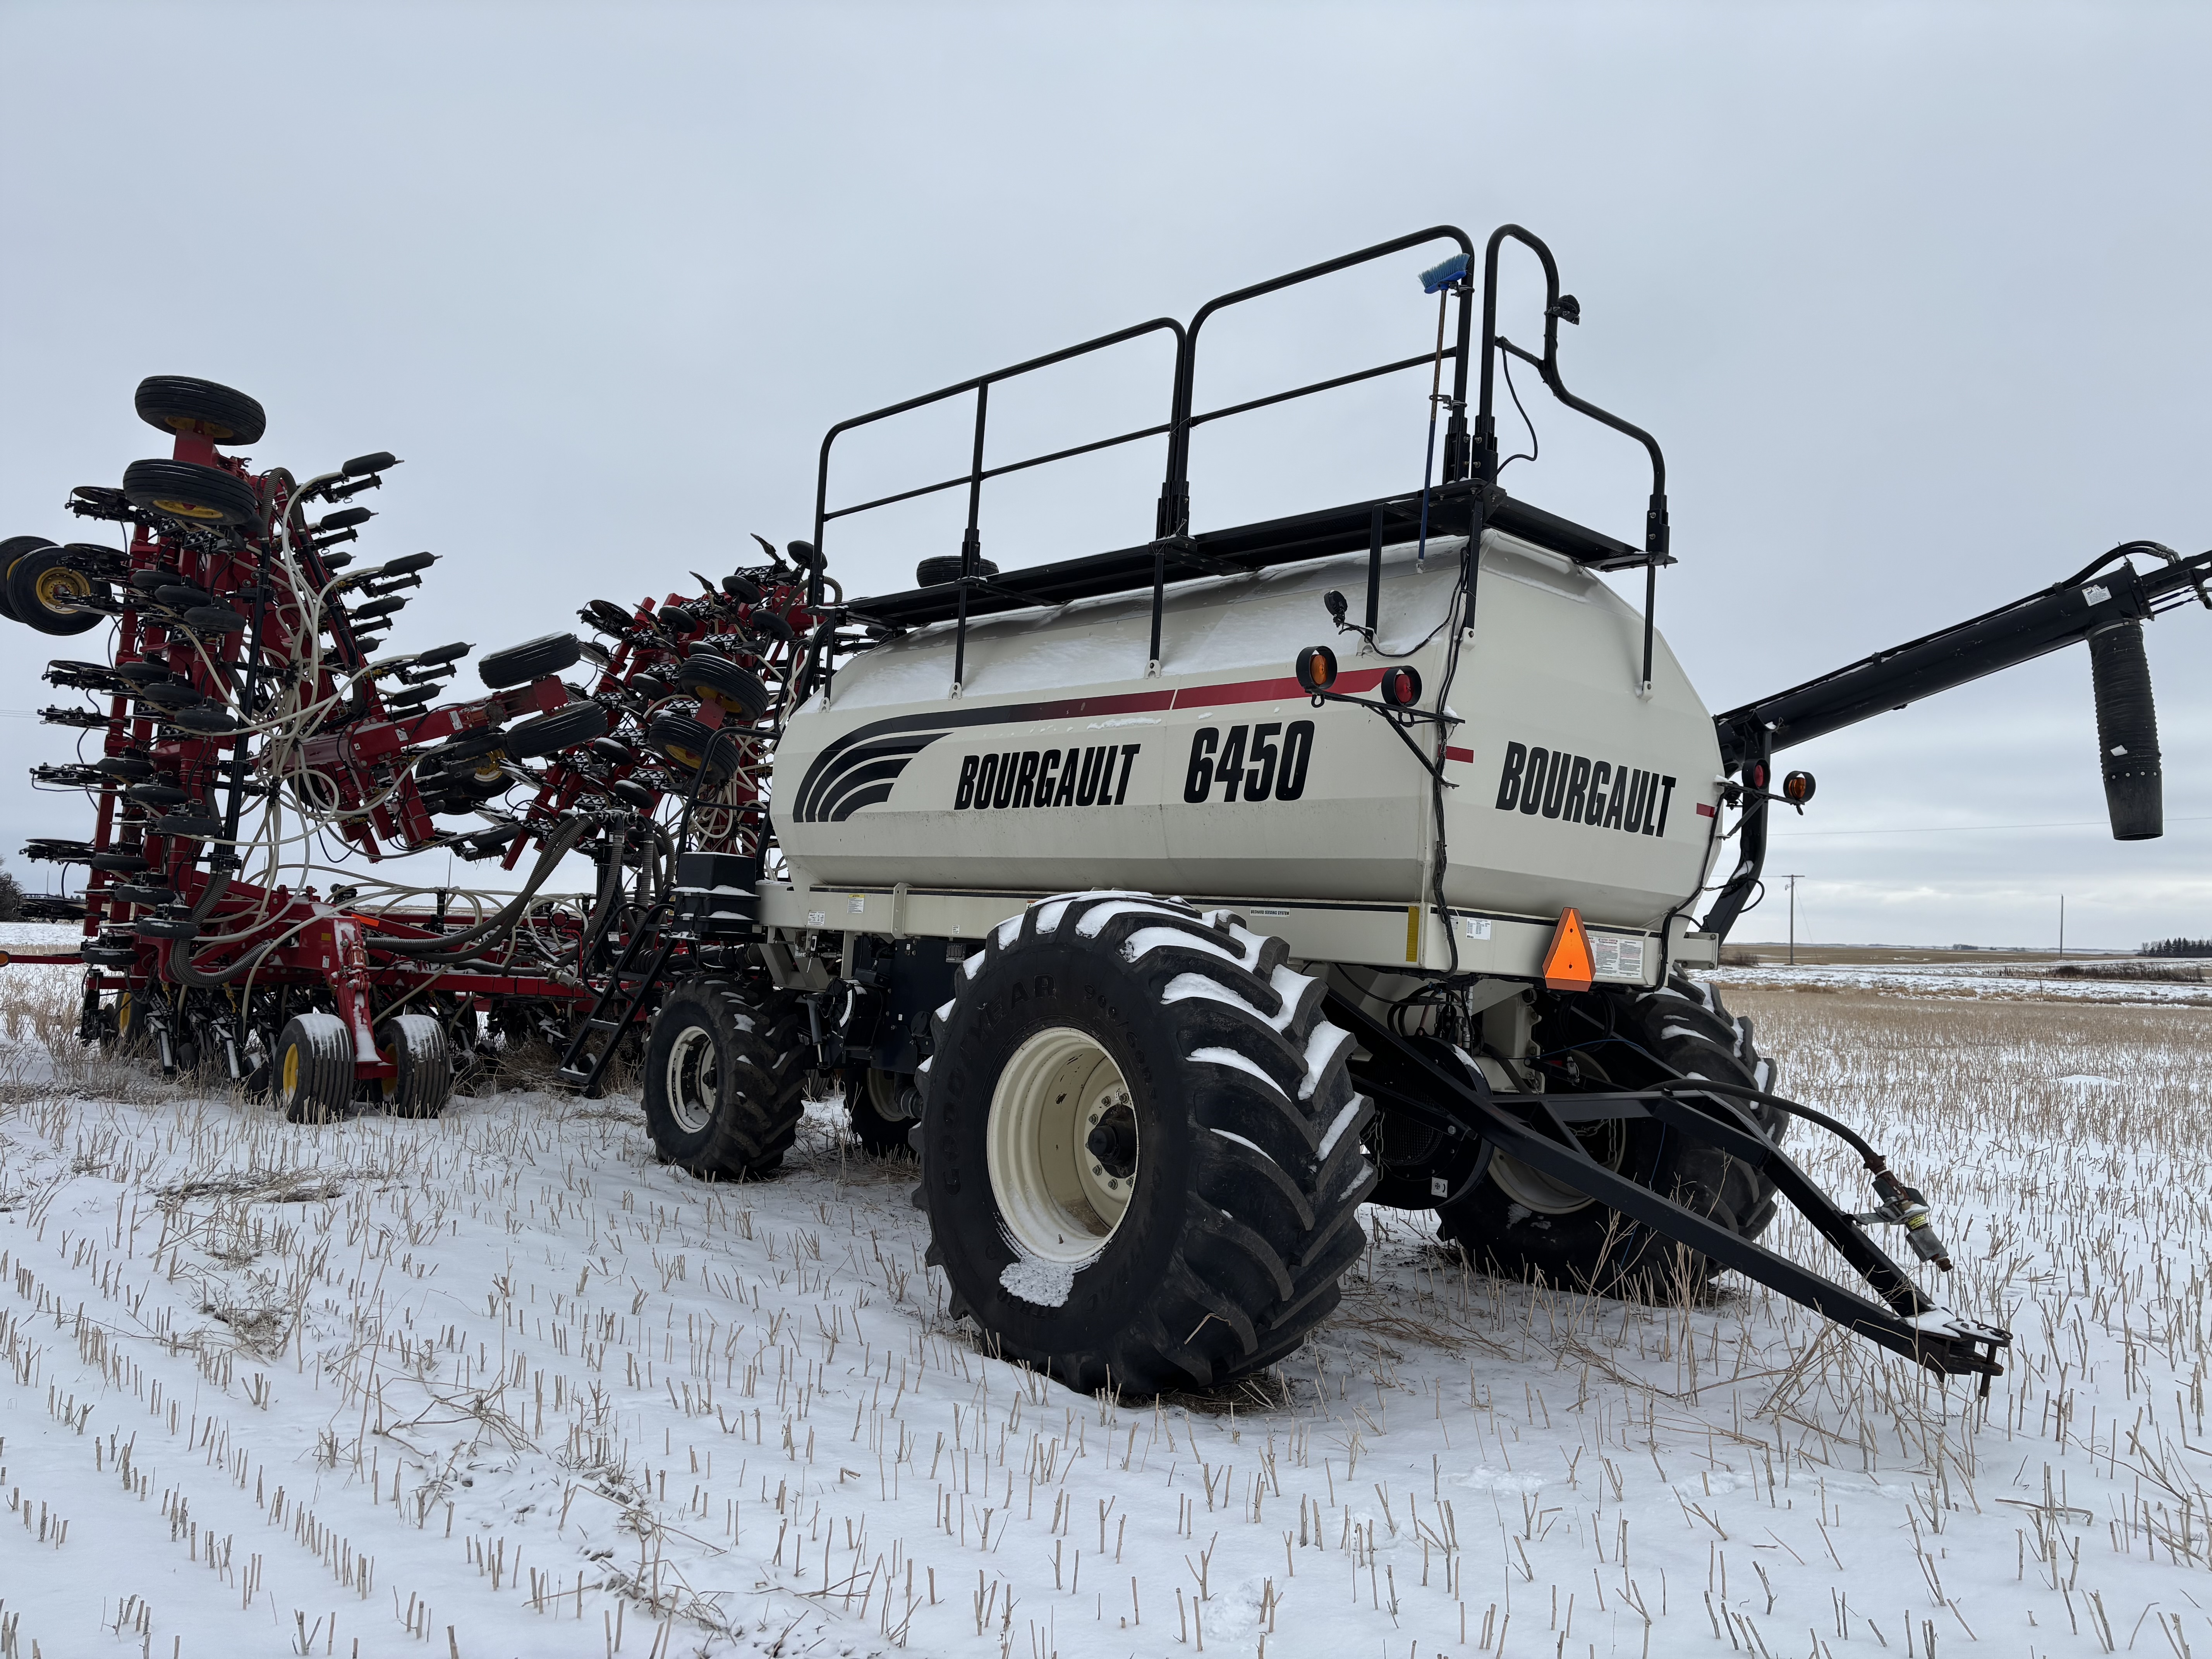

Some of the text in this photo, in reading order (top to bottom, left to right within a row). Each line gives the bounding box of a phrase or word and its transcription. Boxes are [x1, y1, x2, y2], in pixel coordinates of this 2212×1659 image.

[955, 720, 1315, 810] BOURGAULT 6450
[1496, 741, 1676, 838] BOURGAULT
